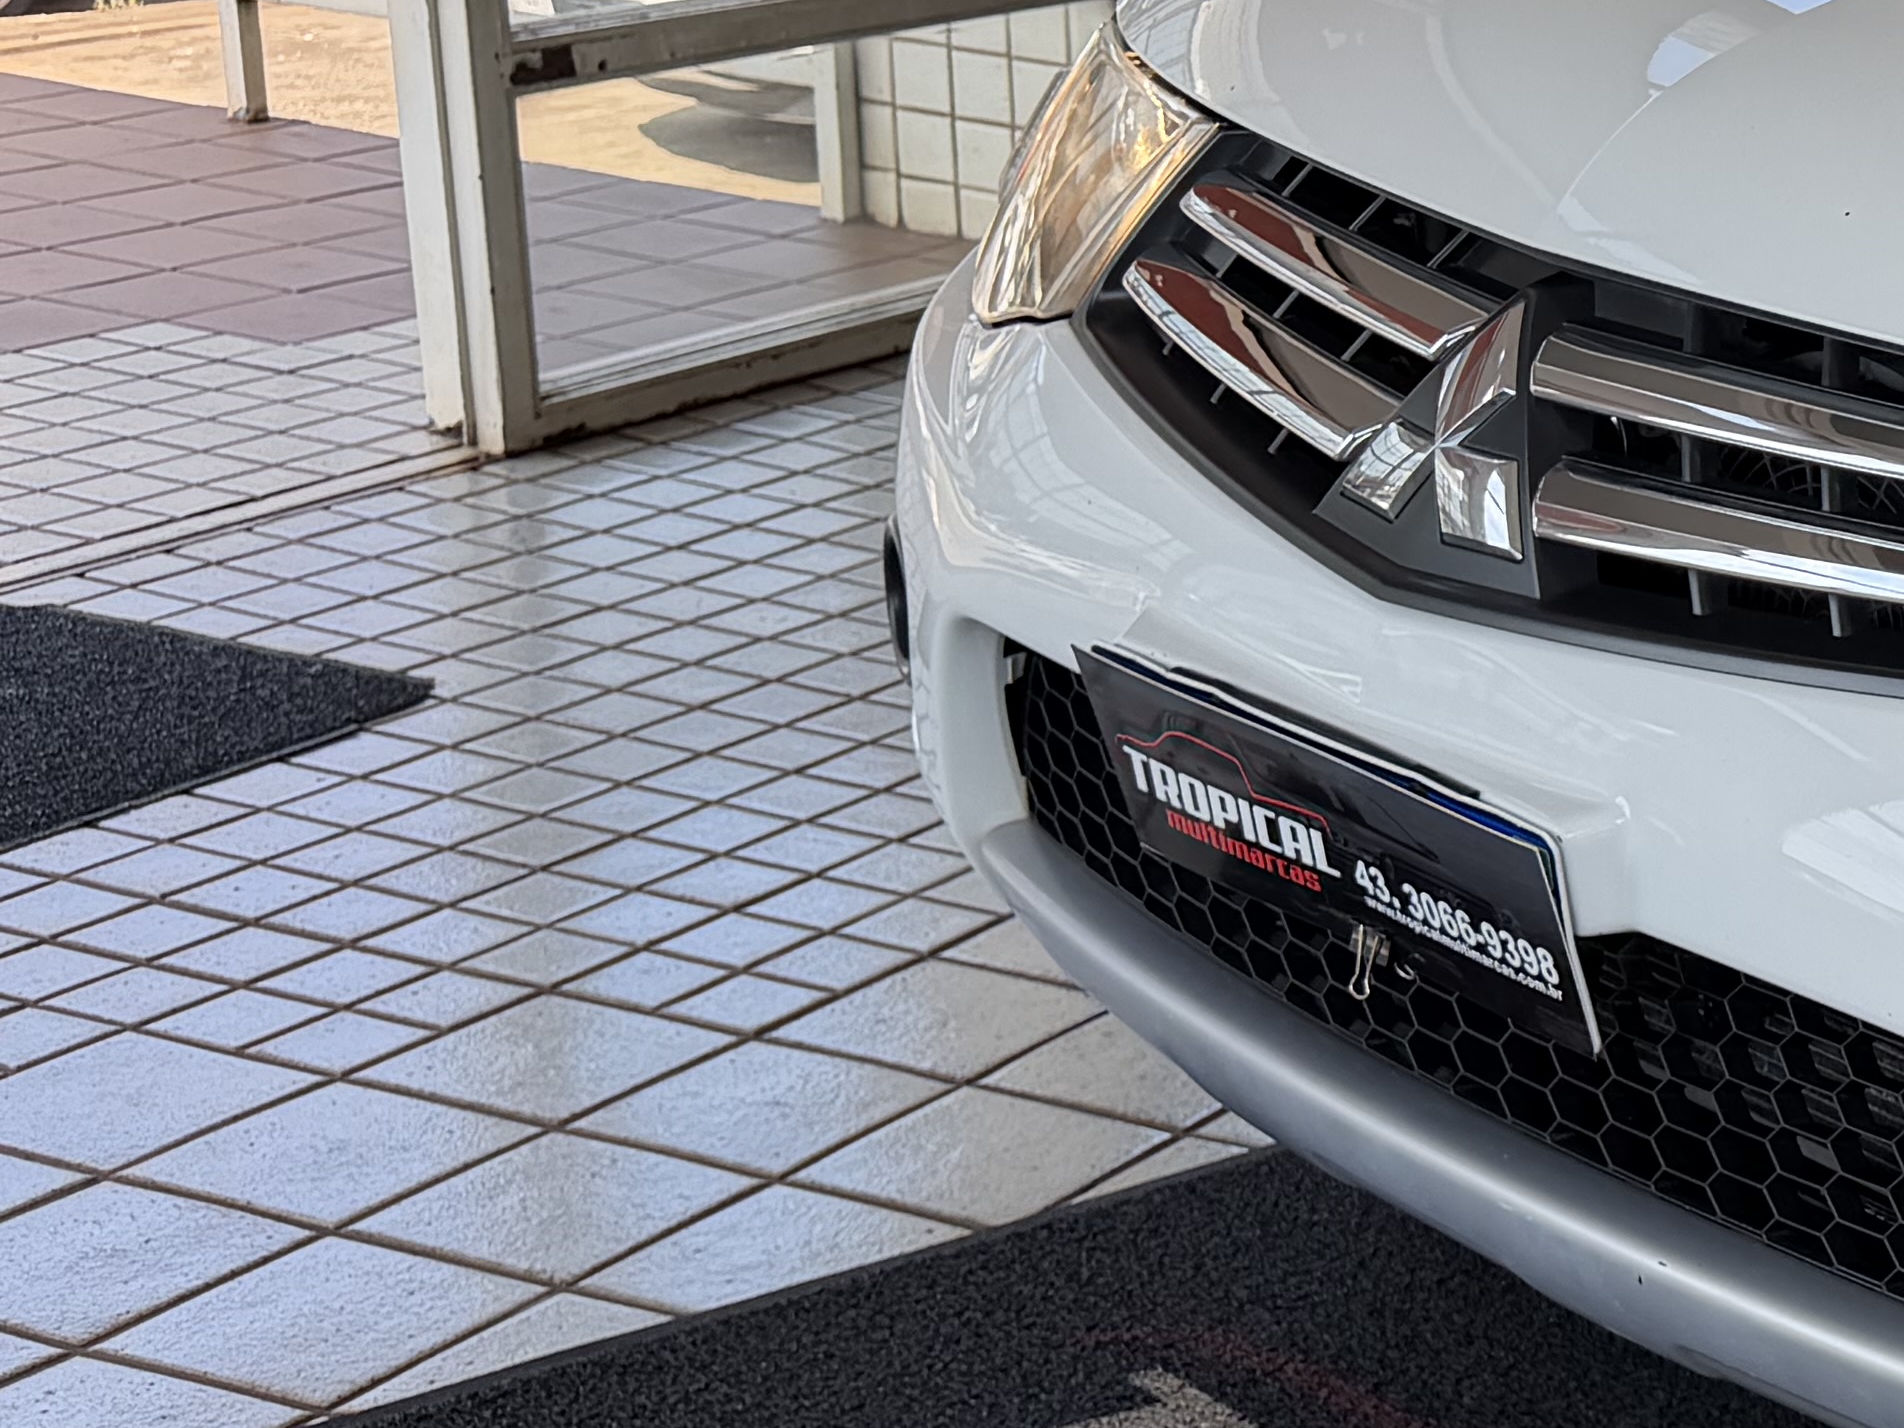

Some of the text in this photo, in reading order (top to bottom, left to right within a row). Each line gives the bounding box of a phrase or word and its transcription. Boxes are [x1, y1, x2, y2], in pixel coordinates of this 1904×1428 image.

[1122, 744, 1342, 878] TROPICAL
[1165, 808, 1323, 893] multimarcas
[1401, 882, 1560, 985] 3066-9398
